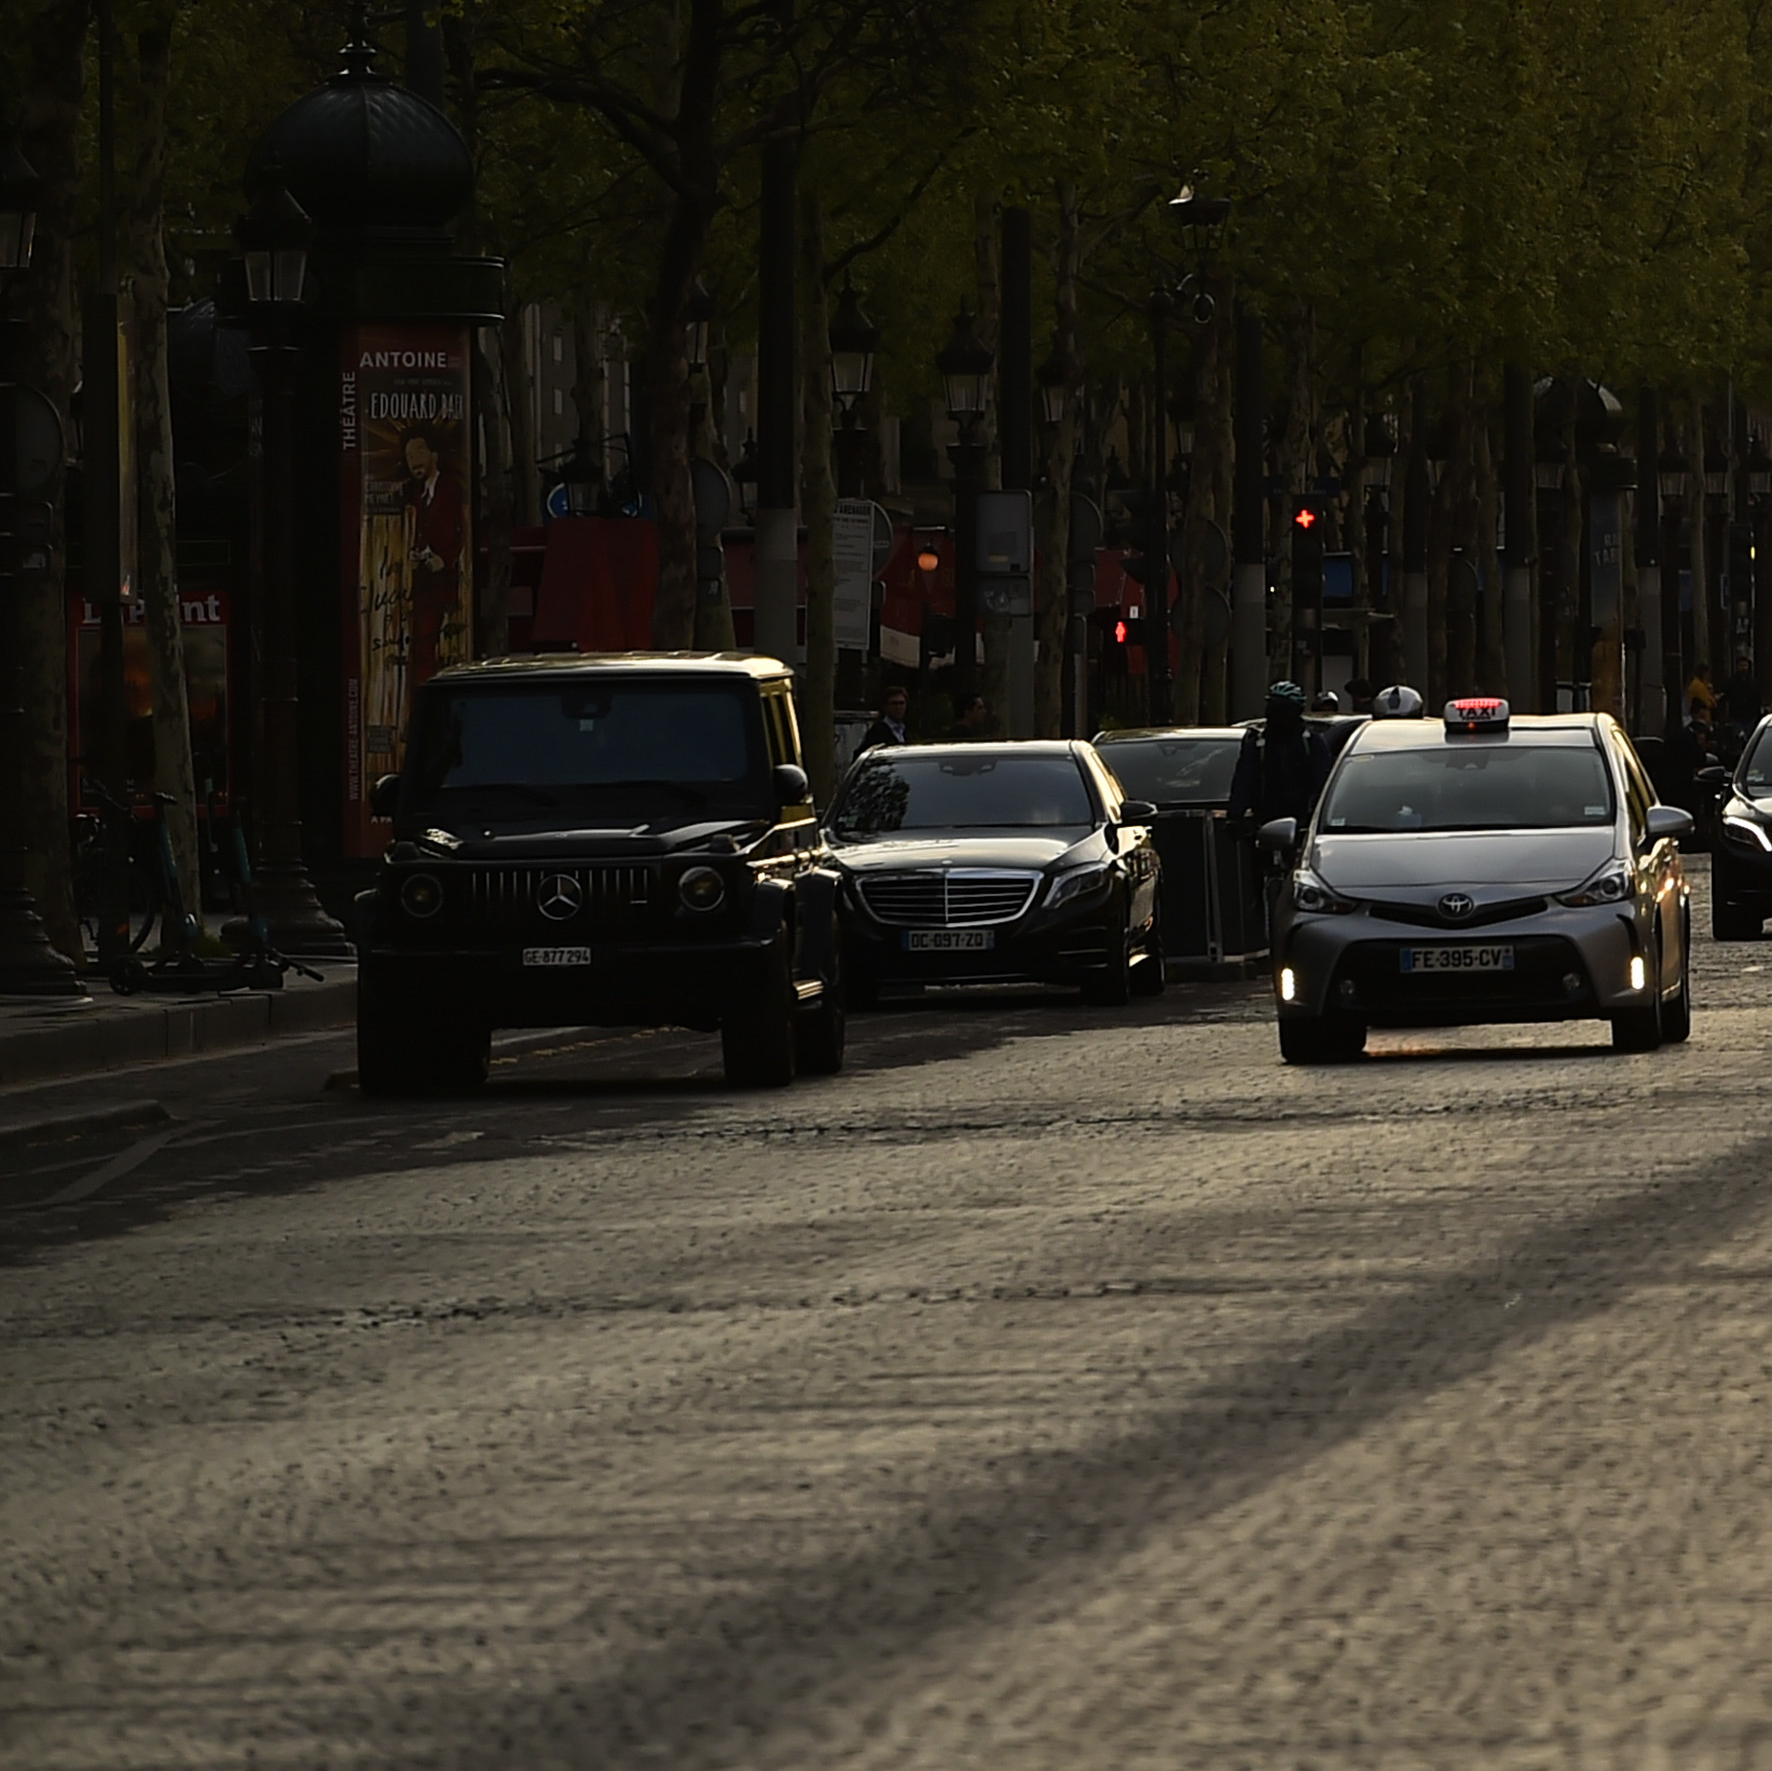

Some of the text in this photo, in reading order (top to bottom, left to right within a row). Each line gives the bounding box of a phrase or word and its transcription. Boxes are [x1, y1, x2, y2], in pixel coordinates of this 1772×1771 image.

[359, 351, 448, 369] ANTOINE
[339, 371, 357, 451] THÉÂTRE
[370, 392, 437, 420] EDOUARD
[129, 593, 222, 624] Pnt
[1455, 707, 1497, 718] TAXI
[1412, 949, 1502, 968] FE-395-CV
